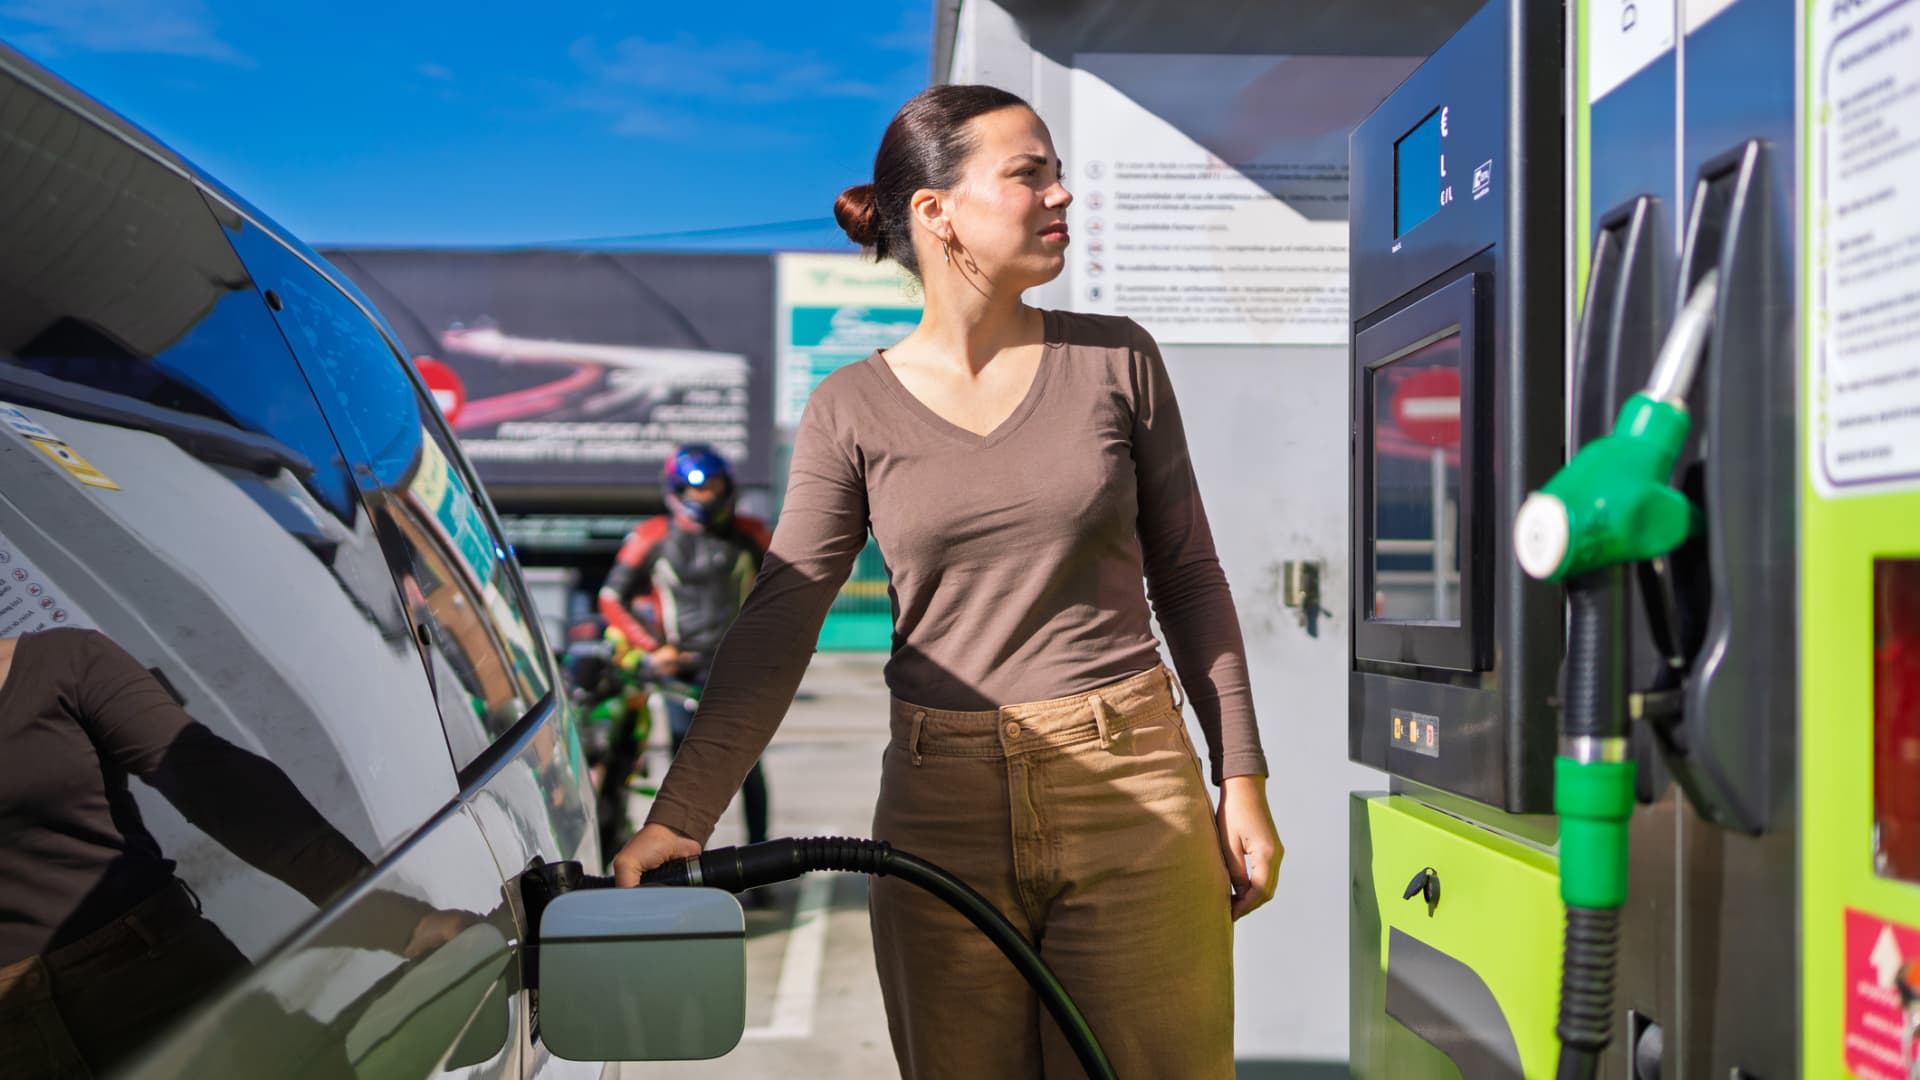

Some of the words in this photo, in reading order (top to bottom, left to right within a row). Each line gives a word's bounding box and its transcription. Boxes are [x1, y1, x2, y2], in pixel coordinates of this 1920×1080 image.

[1621, 0, 1638, 32] D
[1440, 106, 1449, 138] €
[1440, 153, 1447, 177] L
